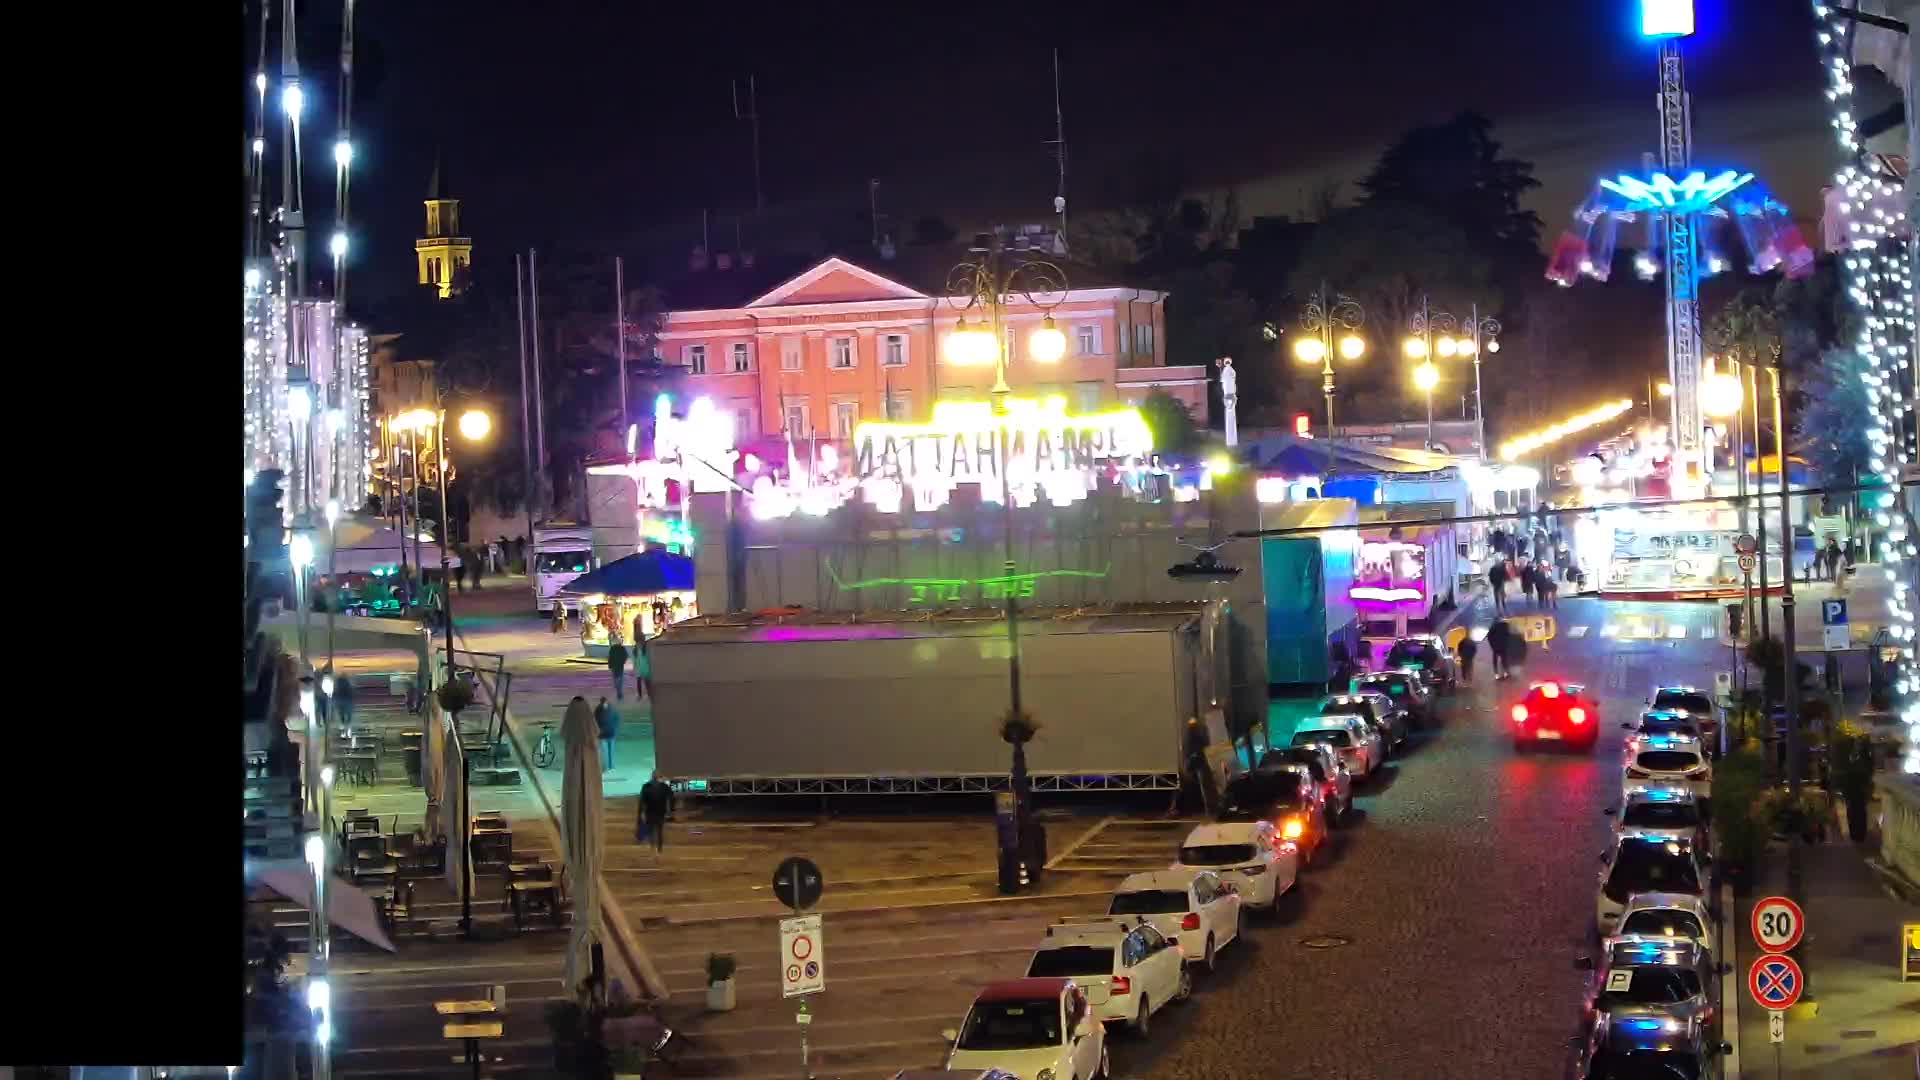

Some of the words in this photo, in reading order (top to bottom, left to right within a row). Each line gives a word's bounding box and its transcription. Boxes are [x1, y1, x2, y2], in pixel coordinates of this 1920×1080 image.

[1827, 602, 1842, 622] P
[1762, 911, 1791, 937] 30
[1611, 973, 1626, 987] P
